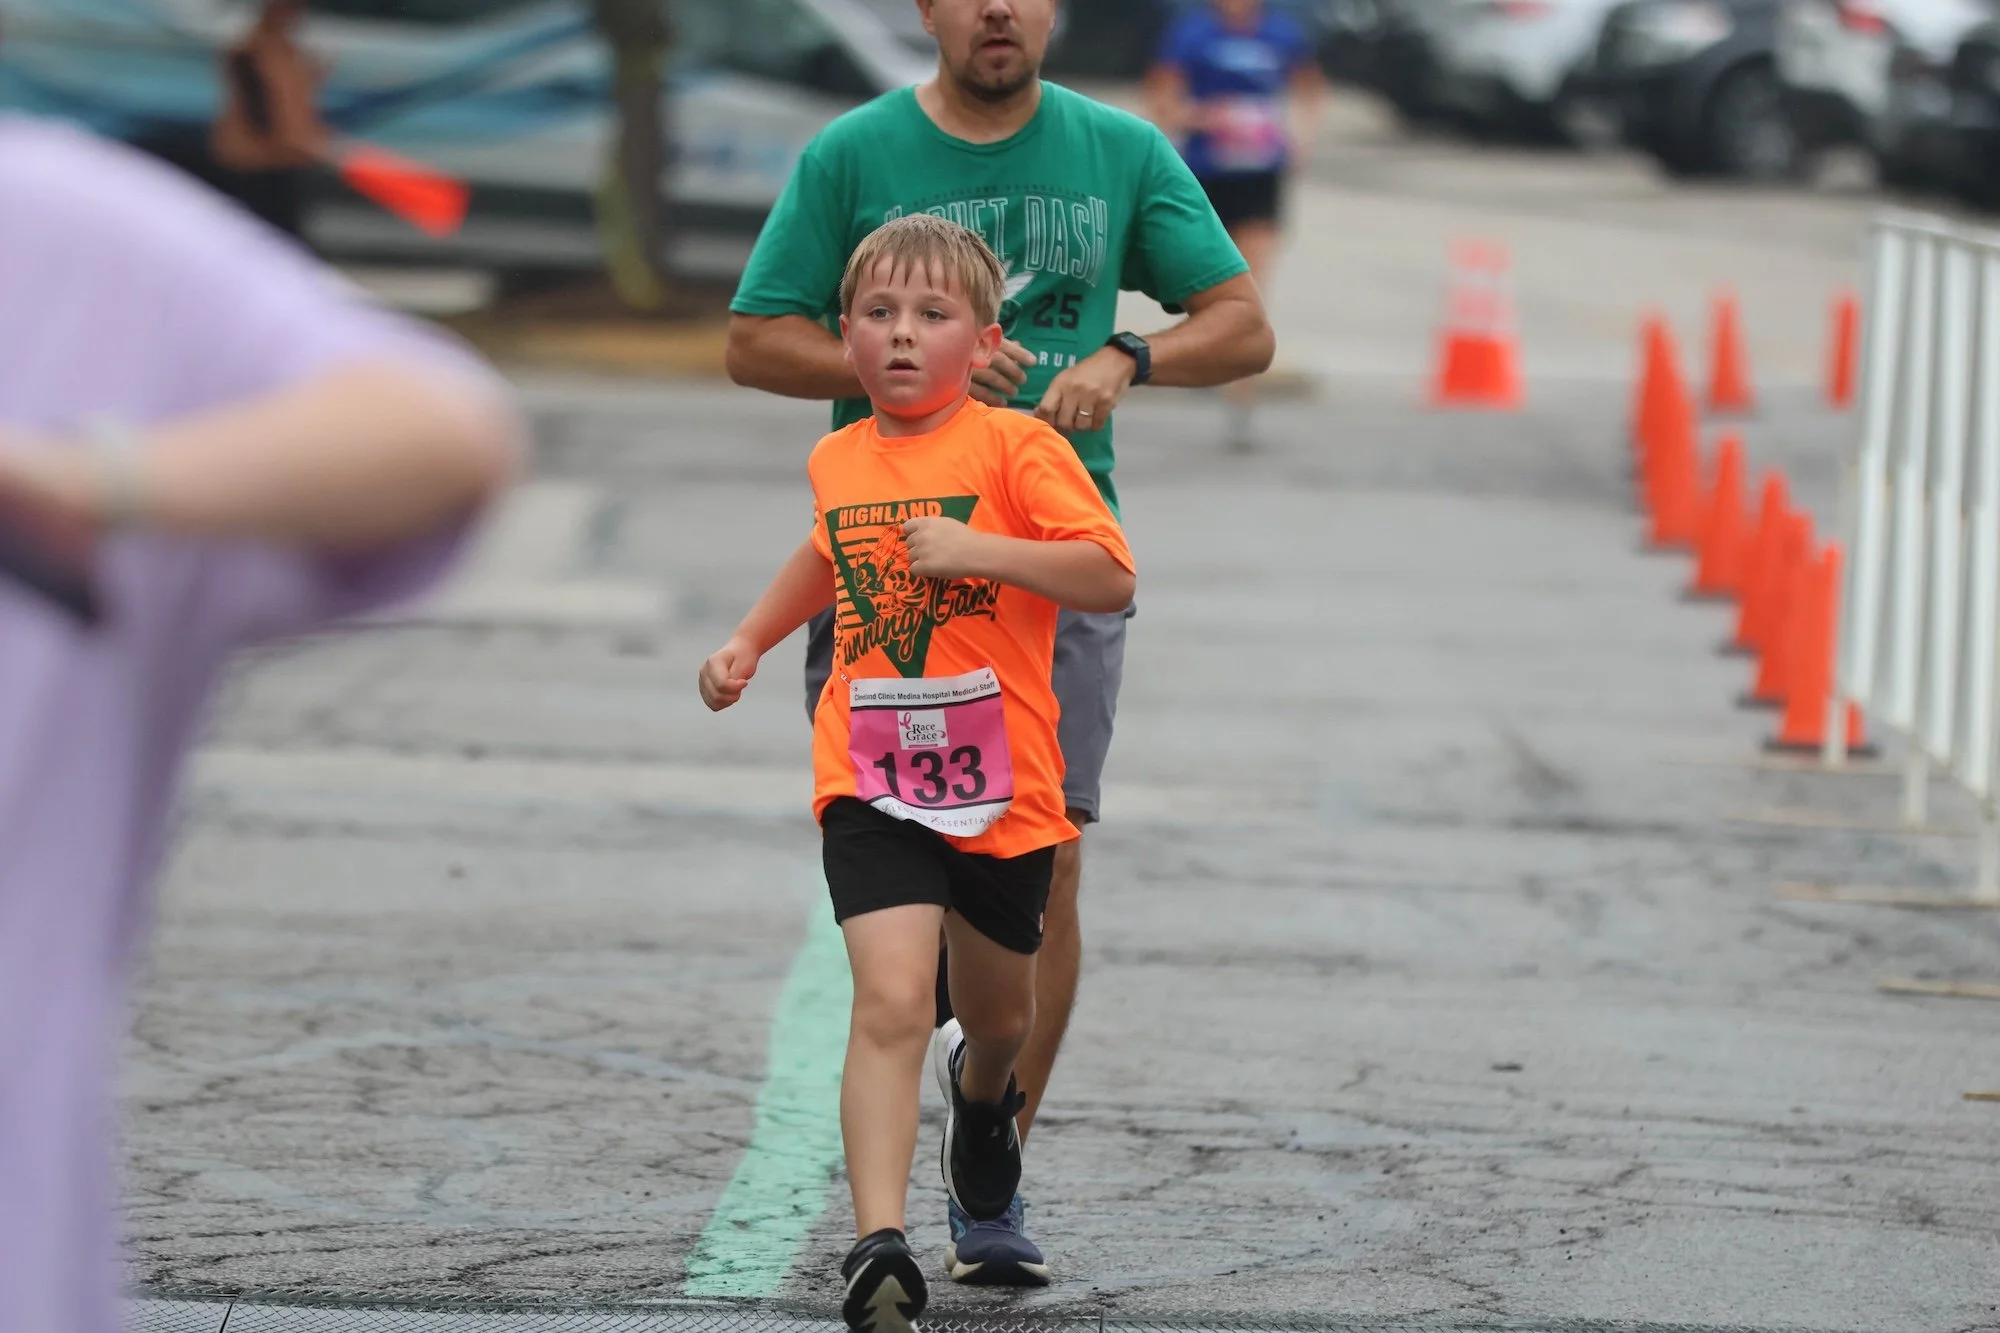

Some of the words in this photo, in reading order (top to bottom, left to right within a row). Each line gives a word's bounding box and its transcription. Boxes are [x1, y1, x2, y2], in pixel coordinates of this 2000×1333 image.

[884, 197, 1008, 262] NET
[1024, 196, 1107, 287] DASH
[1039, 351, 1077, 368] RUN
[838, 501, 942, 528] HIGHLAND
[838, 607, 924, 662] unning
[877, 692, 896, 700] Clinic
[897, 692, 921, 700] Medina
[922, 691, 950, 700] Hospital
[952, 687, 978, 697] Medical
[979, 681, 995, 691] Staff
[906, 730, 938, 741] Grace
[911, 723, 936, 734] Race
[873, 745, 987, 804] 133
